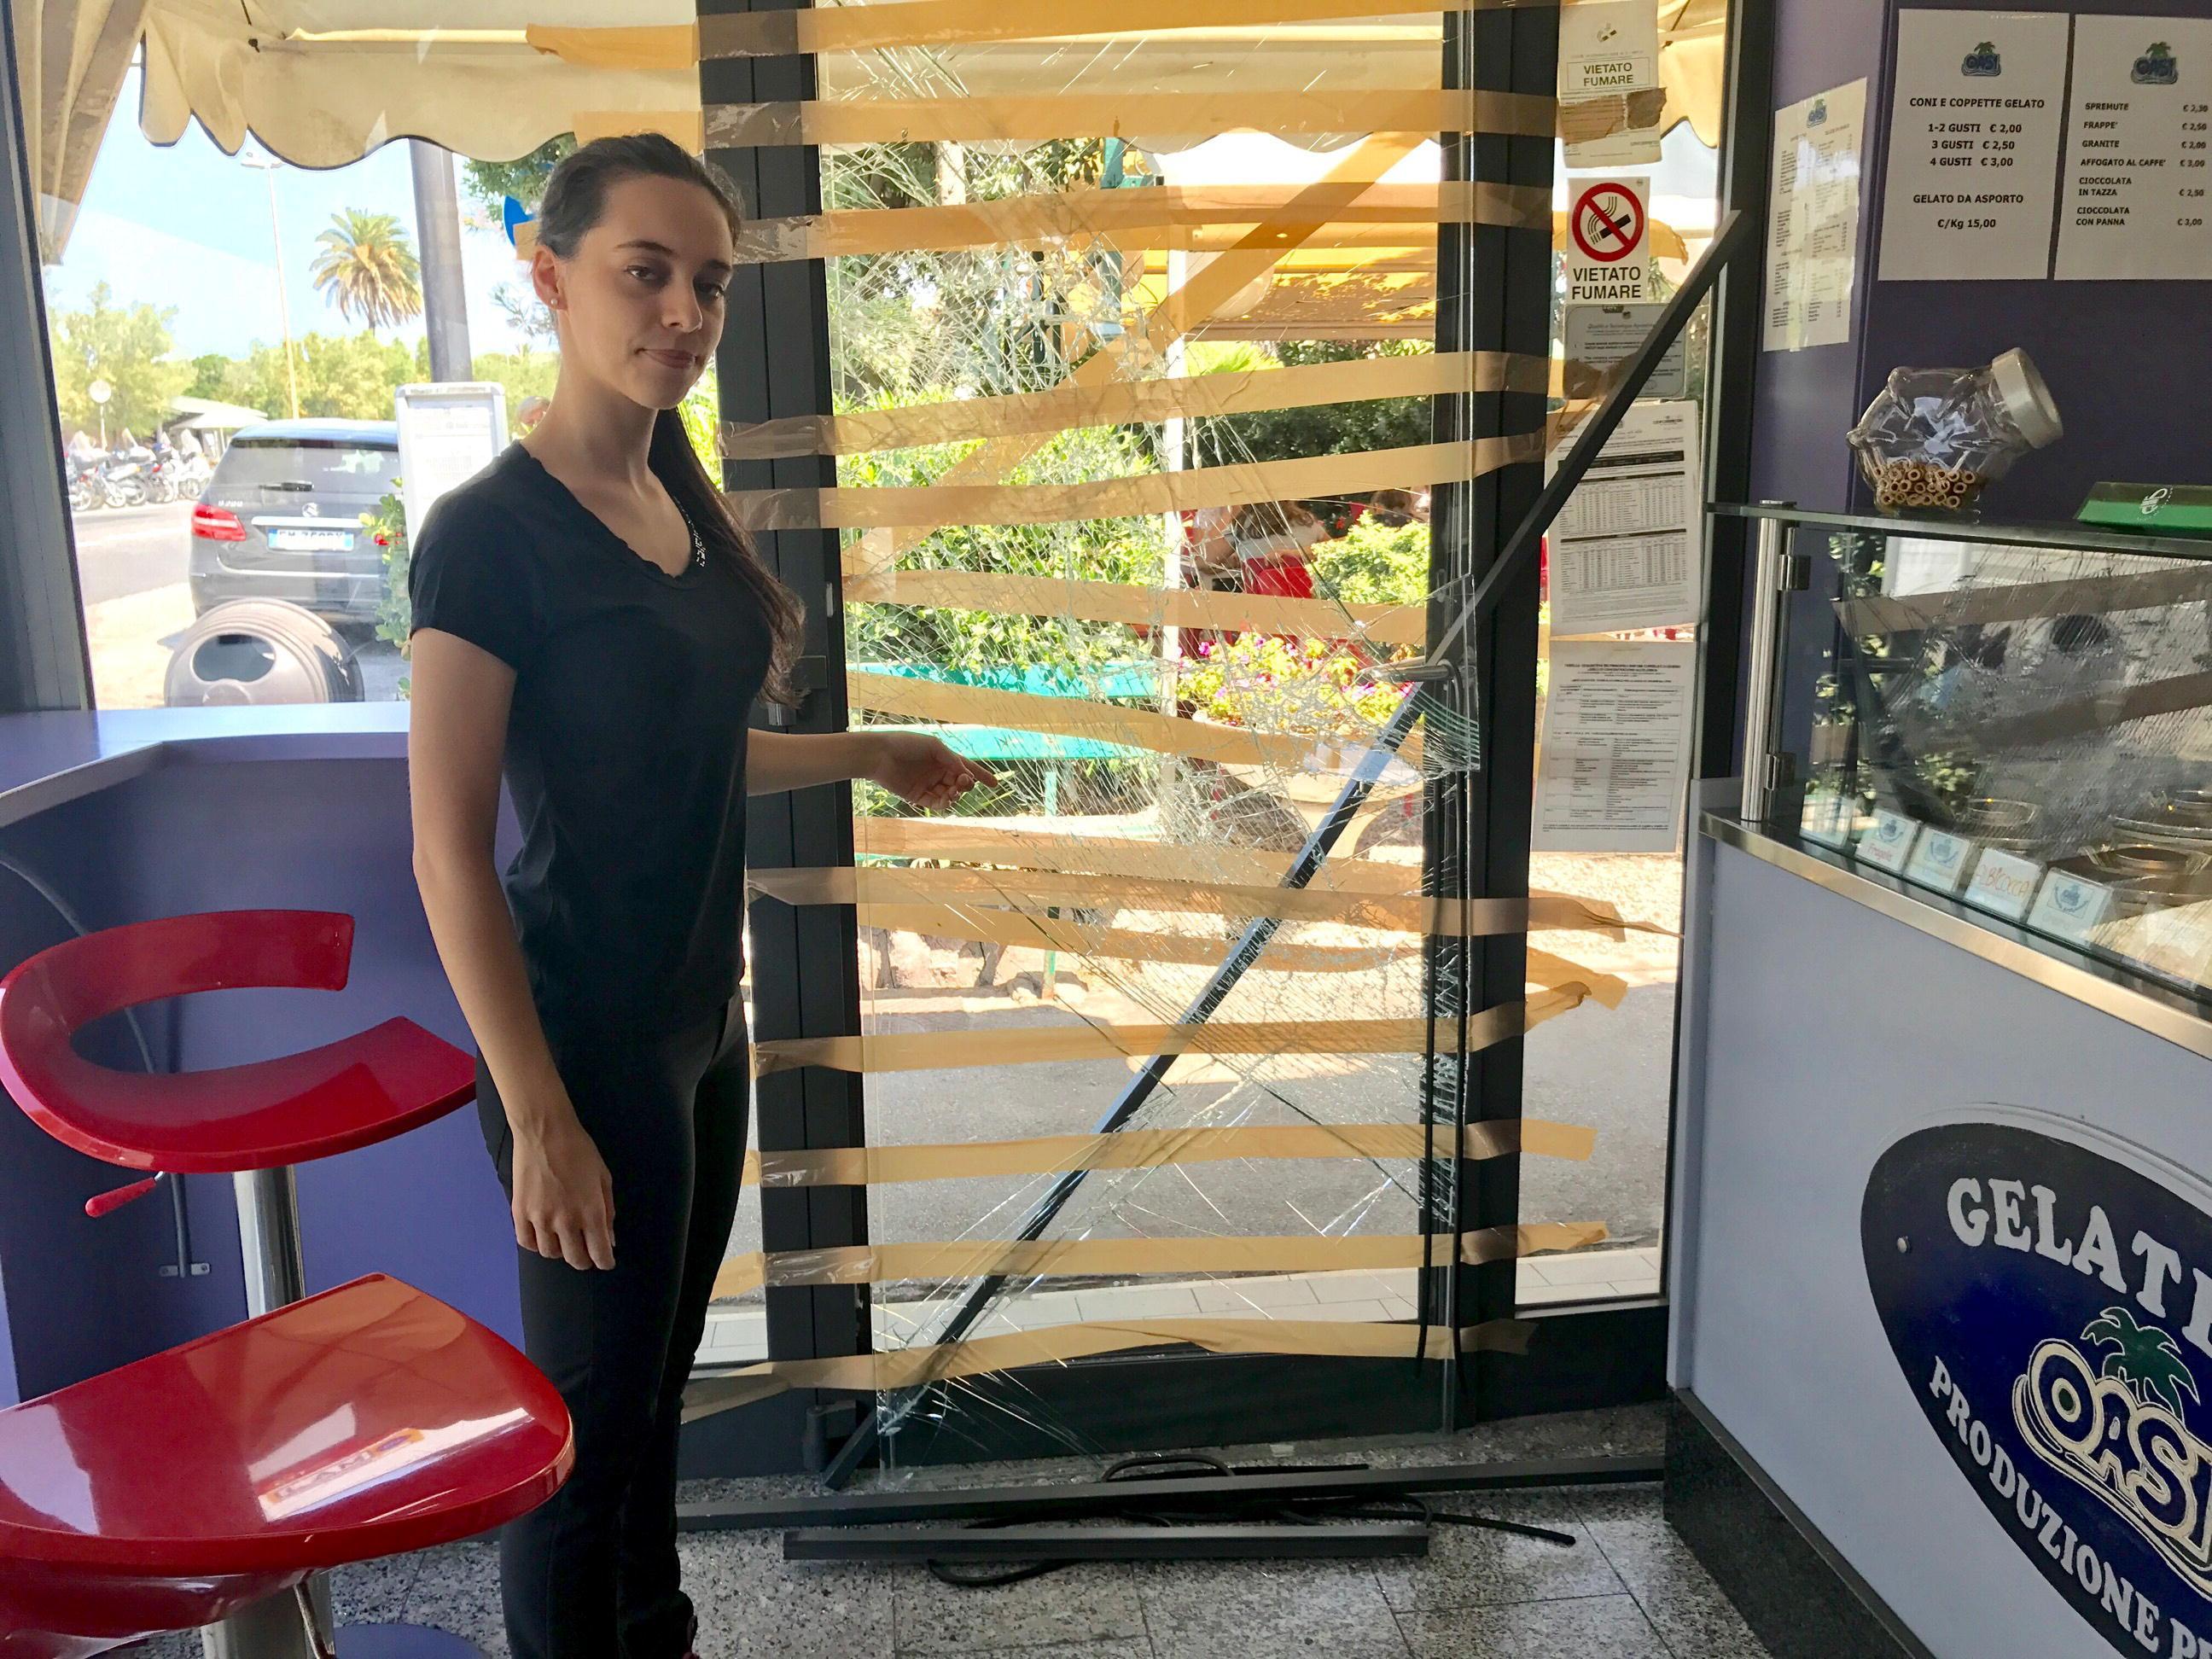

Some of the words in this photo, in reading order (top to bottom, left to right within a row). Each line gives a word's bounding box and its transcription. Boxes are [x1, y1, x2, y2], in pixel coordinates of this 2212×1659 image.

[1583, 62, 1633, 75] VIETATO
[1583, 74, 1634, 86] FUMARE
[1909, 97, 1937, 107] CONI
[1940, 98, 1947, 107] E
[1949, 98, 2002, 108] COPPETTE
[2005, 99, 2045, 108] GELATO
[2085, 102, 2130, 111] SPREMUTE
[1928, 124, 1946, 132] 1-2
[1948, 124, 1981, 132] GUSTI
[1989, 124, 1997, 133] €
[2000, 124, 2023, 135] 2,00
[1931, 140, 1938, 149] 3
[1941, 140, 1974, 149] GUSTI
[1982, 140, 1990, 149] €
[1992, 141, 2015, 151] 2,50
[1930, 157, 1936, 166] 4
[1939, 157, 1972, 166] GUSTI
[1981, 158, 1988, 166] €
[1990, 158, 2013, 168] 3,00
[2079, 177, 2132, 185] CIOCCOLATA
[2187, 189, 2204, 198] 2,50
[1912, 195, 1954, 204] GELATO
[1957, 195, 1971, 203] DA
[1974, 195, 2023, 204] ASPORTO
[1937, 218, 1964, 230] €/Kg
[1967, 218, 1996, 230] 15,00
[2184, 218, 2203, 228] 3,00
[1573, 266, 1641, 282] VIETATO
[1572, 284, 1641, 300] FUMARE
[1929, 1355, 2160, 1654] PRODUZIONE
